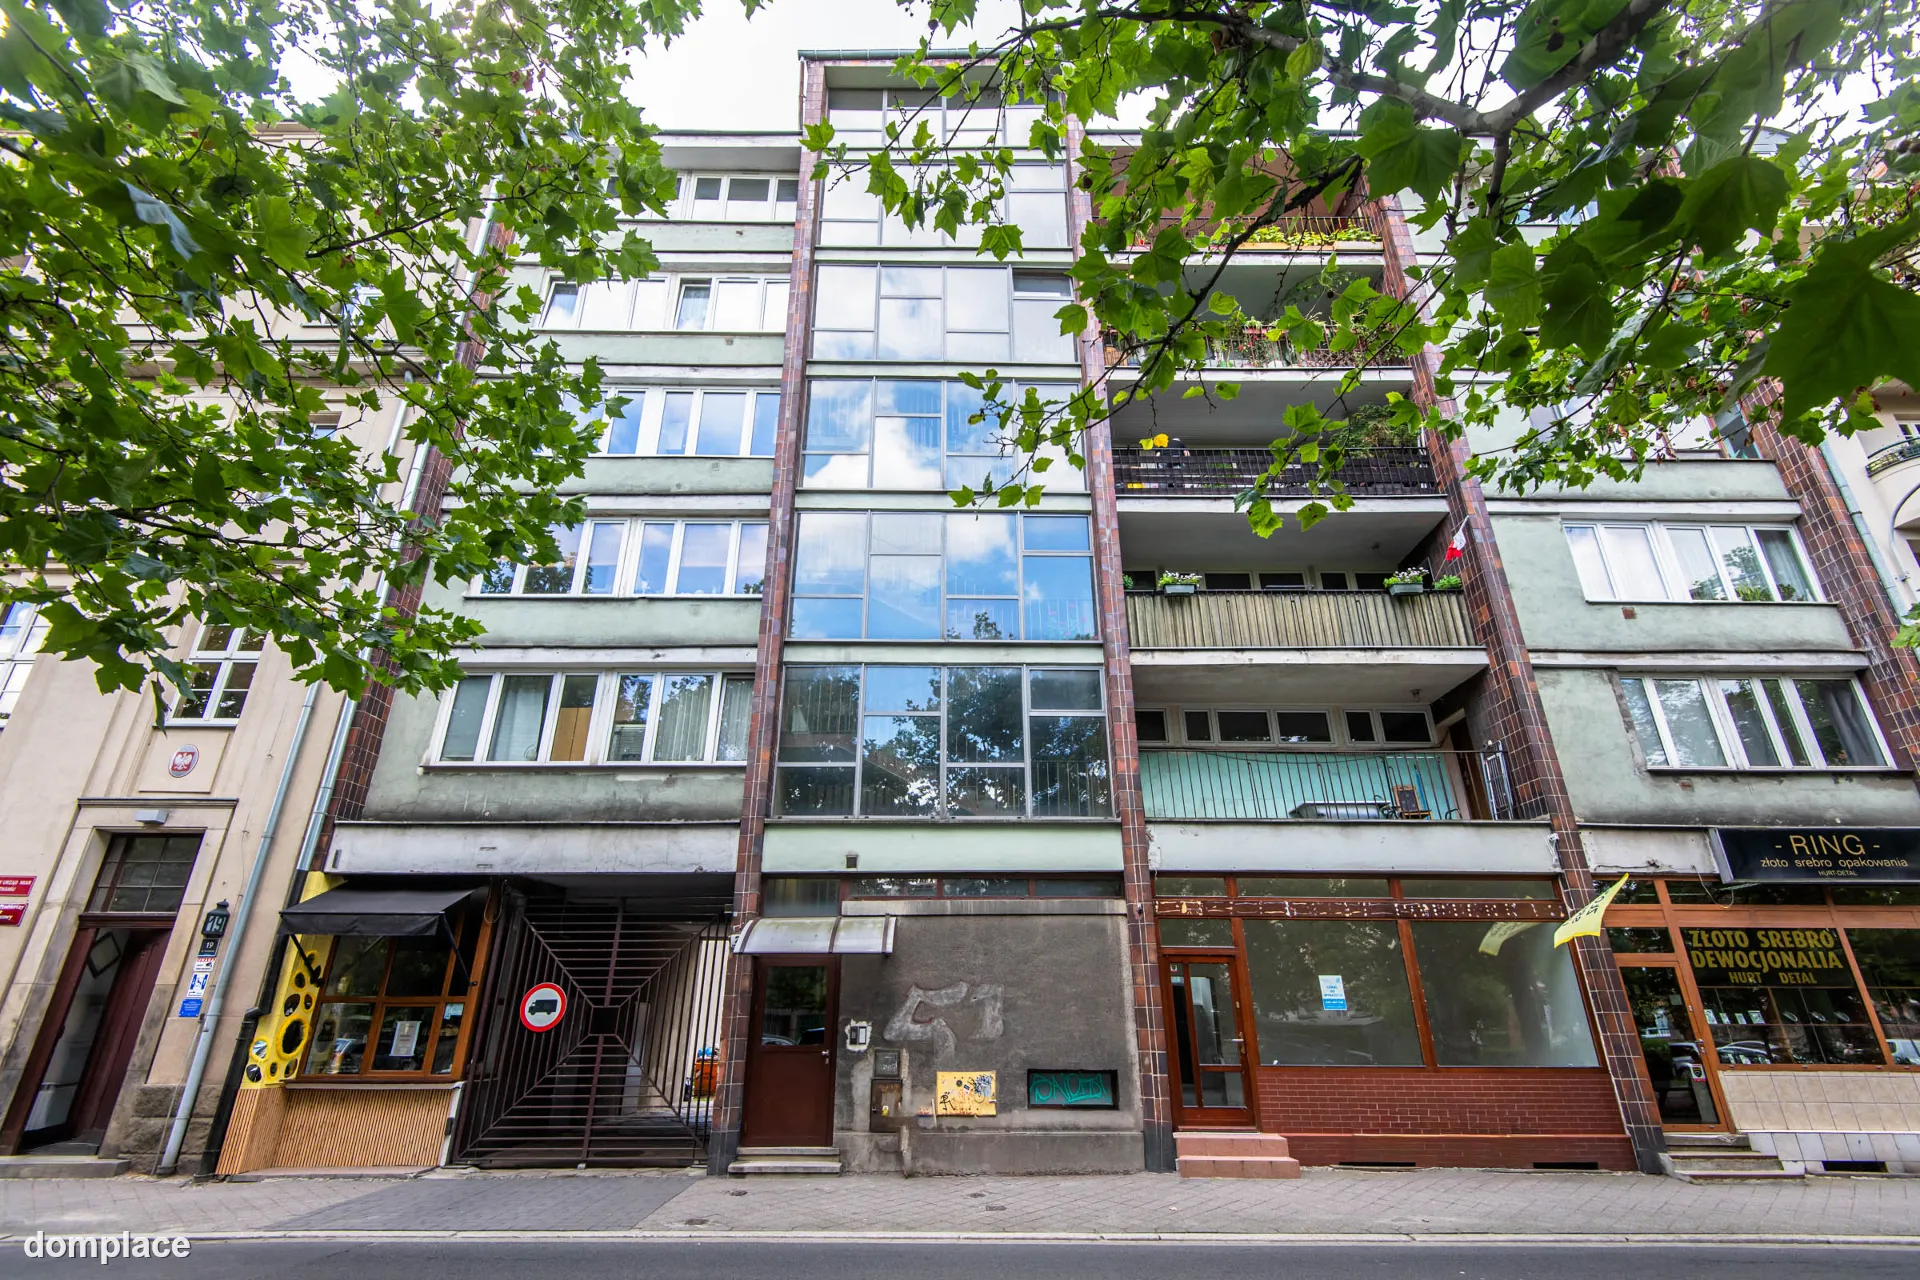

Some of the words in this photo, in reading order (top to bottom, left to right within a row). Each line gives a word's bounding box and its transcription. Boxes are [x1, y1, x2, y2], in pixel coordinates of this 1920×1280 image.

[1789, 834, 1866, 855] RING
[1760, 857, 1789, 868] złoto
[1794, 857, 1833, 868] srebro
[1838, 857, 1909, 870] opakowania
[205, 915, 227, 933] 19
[206, 941, 215, 949] 19
[1688, 930, 1749, 948] ZŁOTO
[1756, 930, 1836, 948] SREBRO
[1690, 950, 1844, 974] DEWOCJONALIA
[1728, 971, 1763, 984] HURT
[1778, 971, 1817, 984] DETAL
